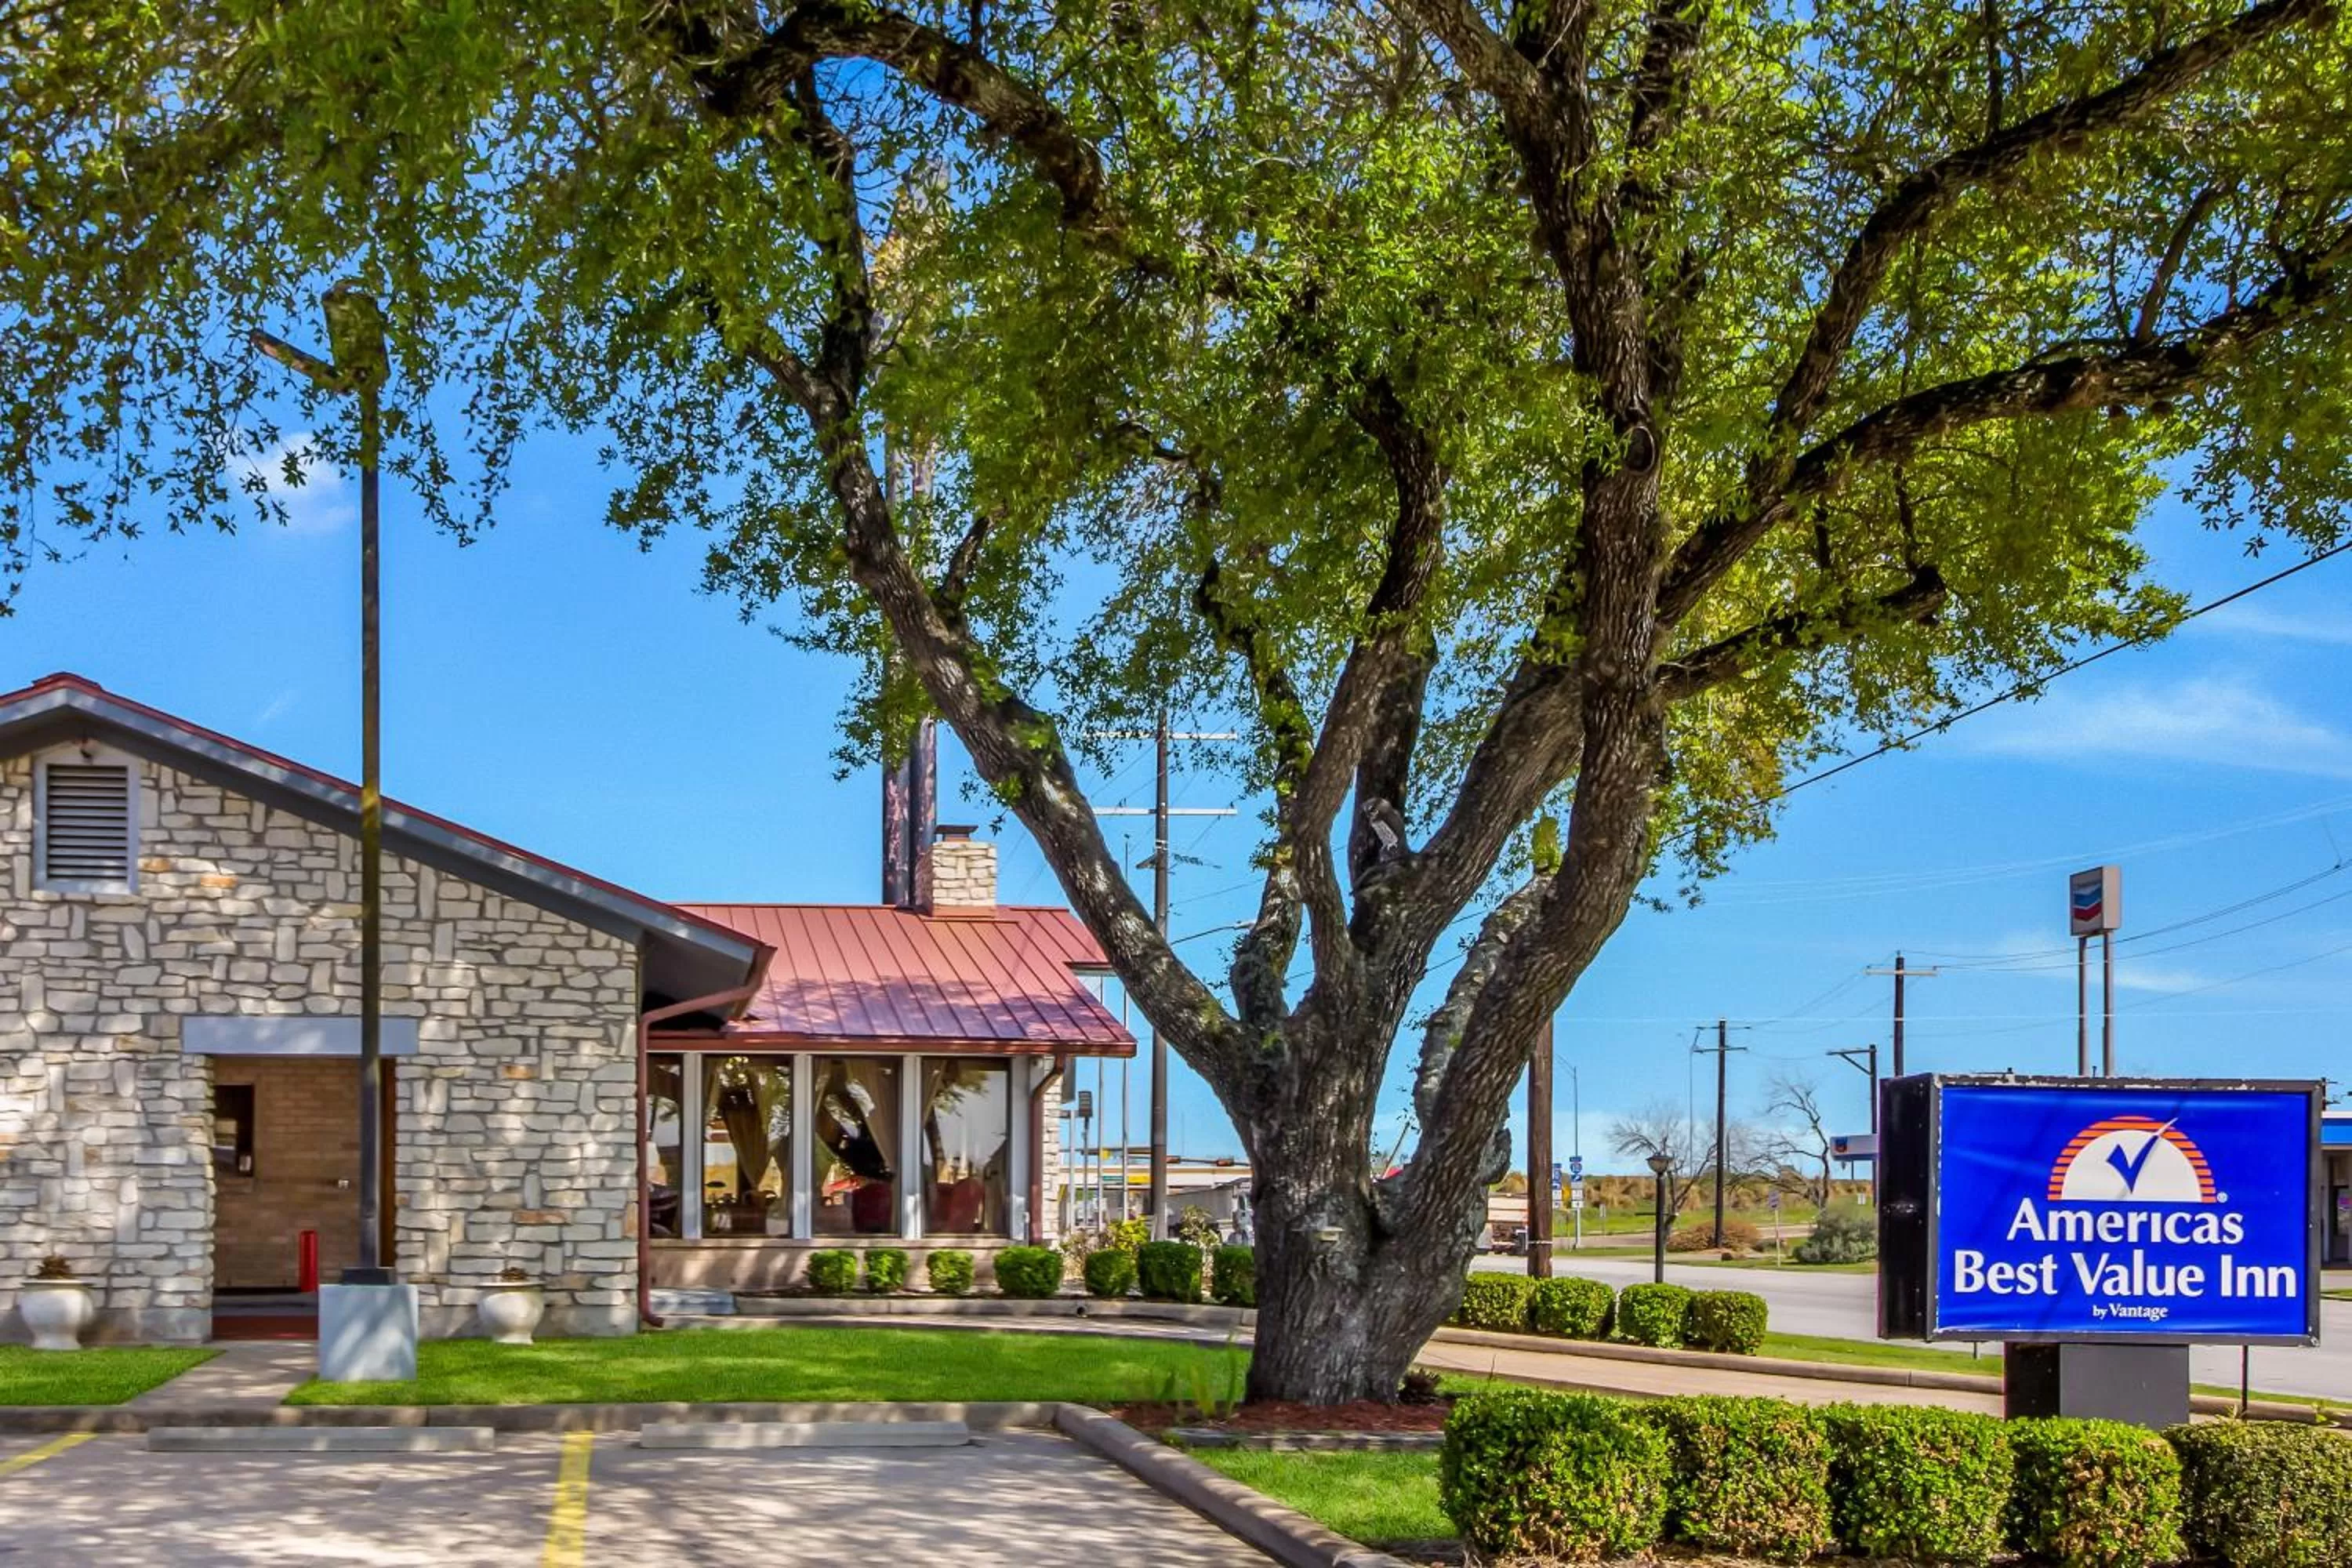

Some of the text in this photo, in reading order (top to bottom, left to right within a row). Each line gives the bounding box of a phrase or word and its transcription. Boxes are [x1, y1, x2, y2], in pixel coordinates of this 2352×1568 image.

[2006, 1197, 2244, 1244] Americas
[1955, 1250, 2296, 1298] Best Value Inn
[2092, 1302, 2169, 1322] by Vantage
